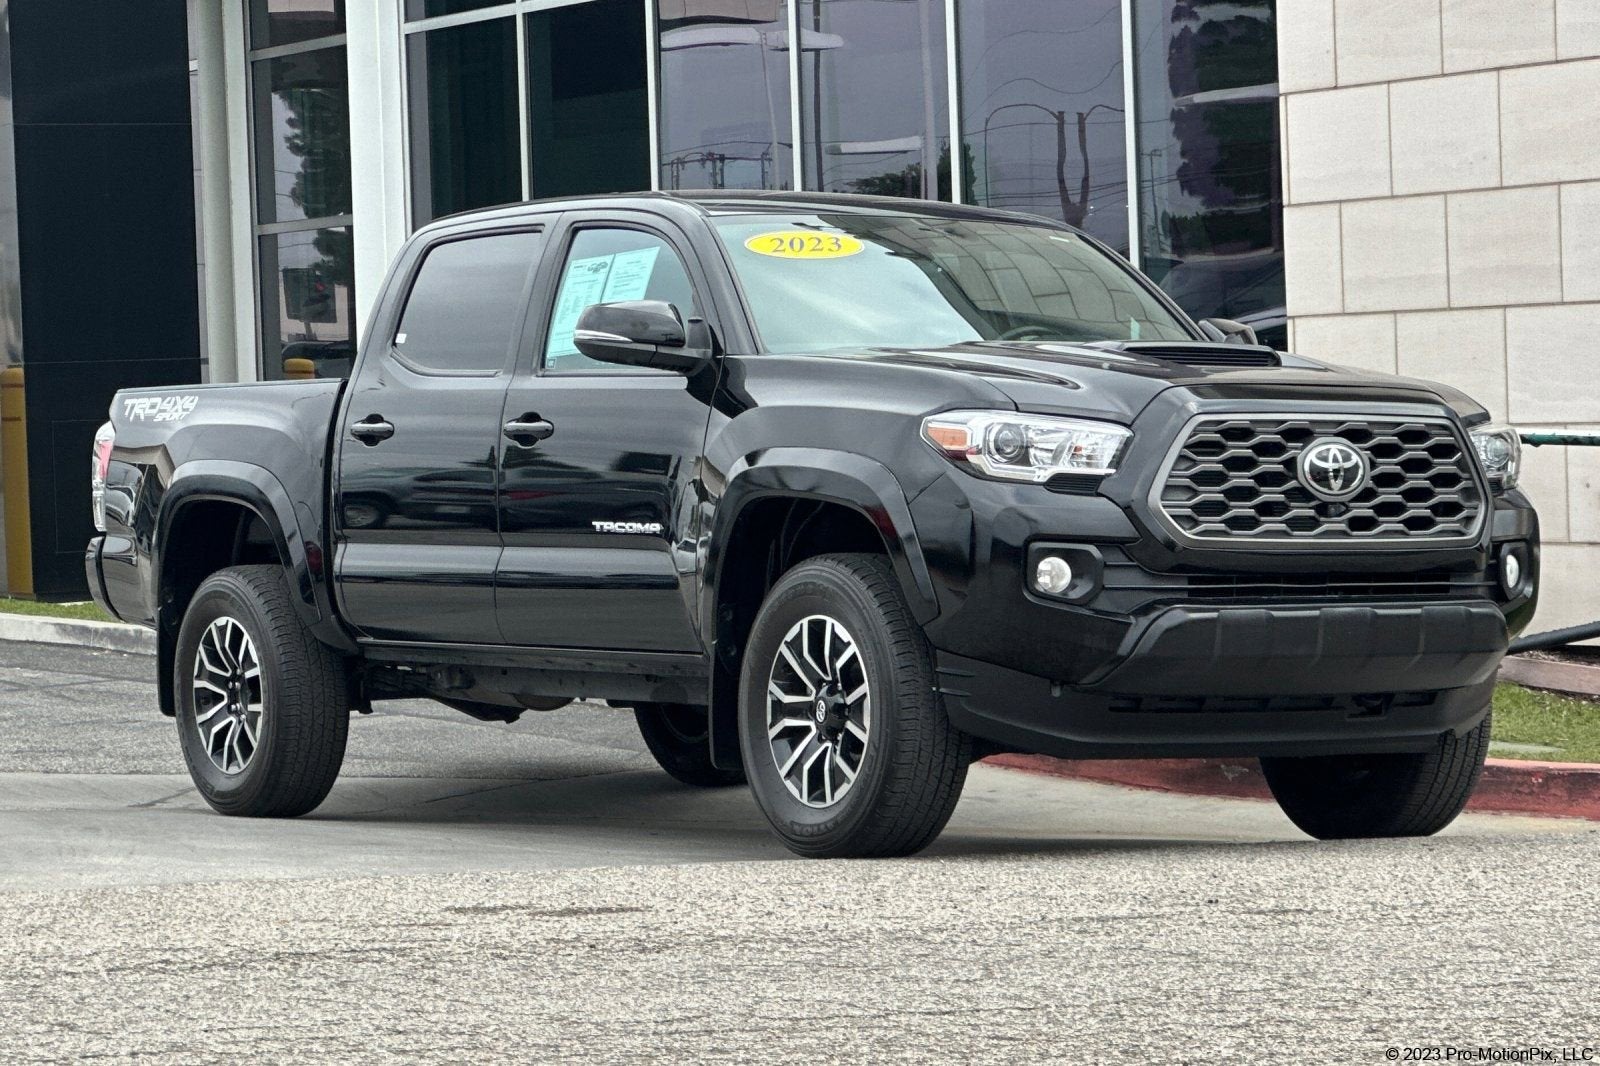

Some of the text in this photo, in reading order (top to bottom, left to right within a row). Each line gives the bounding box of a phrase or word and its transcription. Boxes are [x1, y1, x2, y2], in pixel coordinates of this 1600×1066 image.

[770, 237, 842, 252] 2023
[153, 411, 190, 422] SPORT
[592, 521, 664, 534] TACOMA
